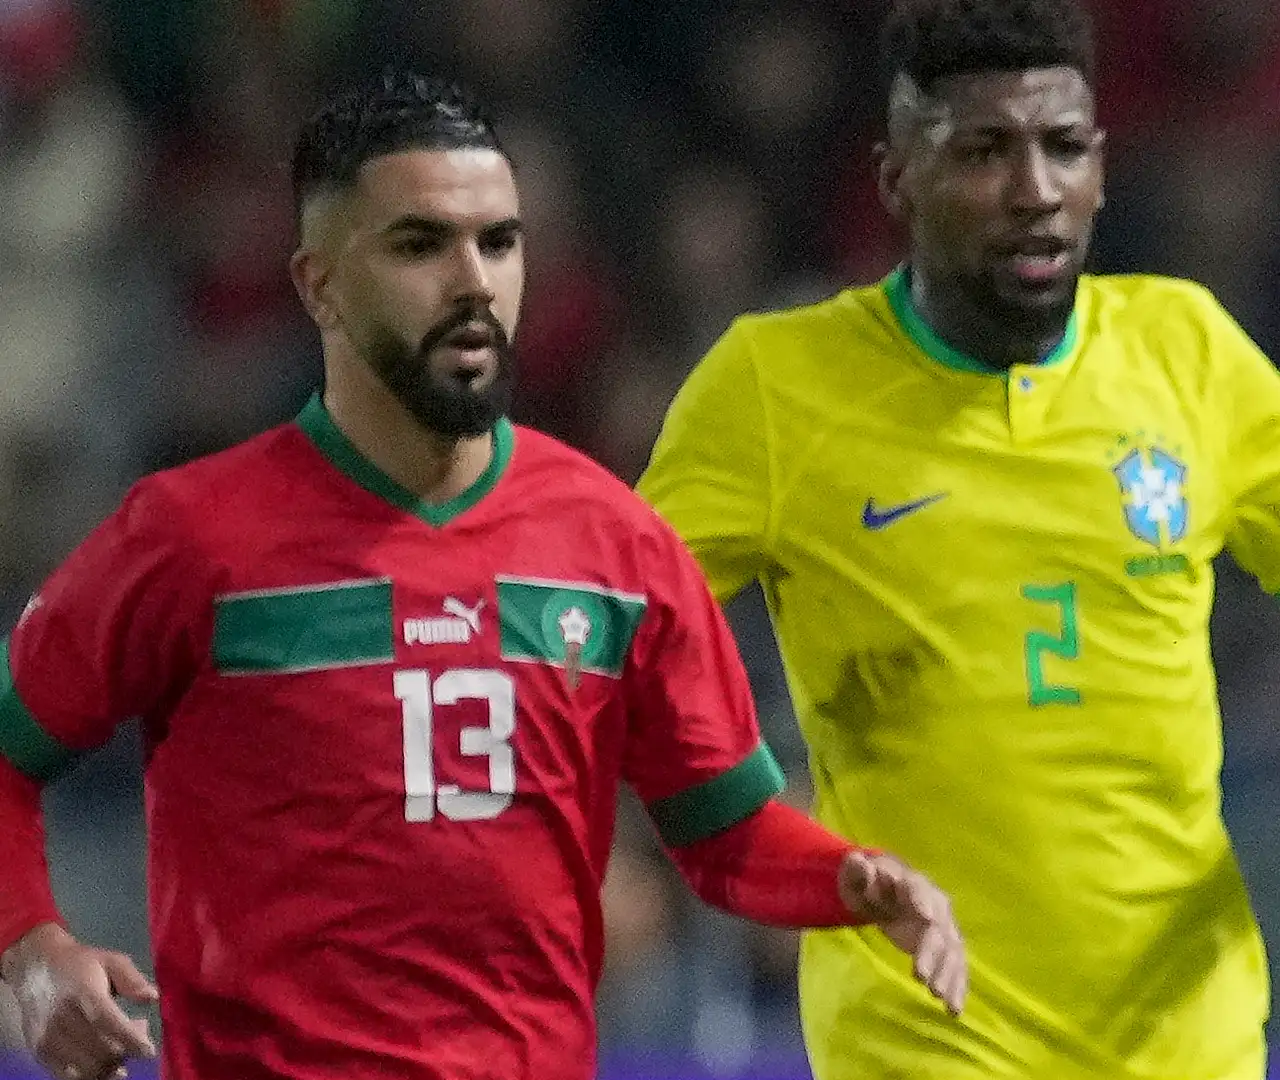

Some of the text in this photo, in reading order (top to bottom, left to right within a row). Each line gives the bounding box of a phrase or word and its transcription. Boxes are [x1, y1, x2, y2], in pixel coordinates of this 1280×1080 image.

[403, 616, 469, 646] PUMA
[1021, 580, 1080, 706] 2
[393, 668, 516, 823] 13
